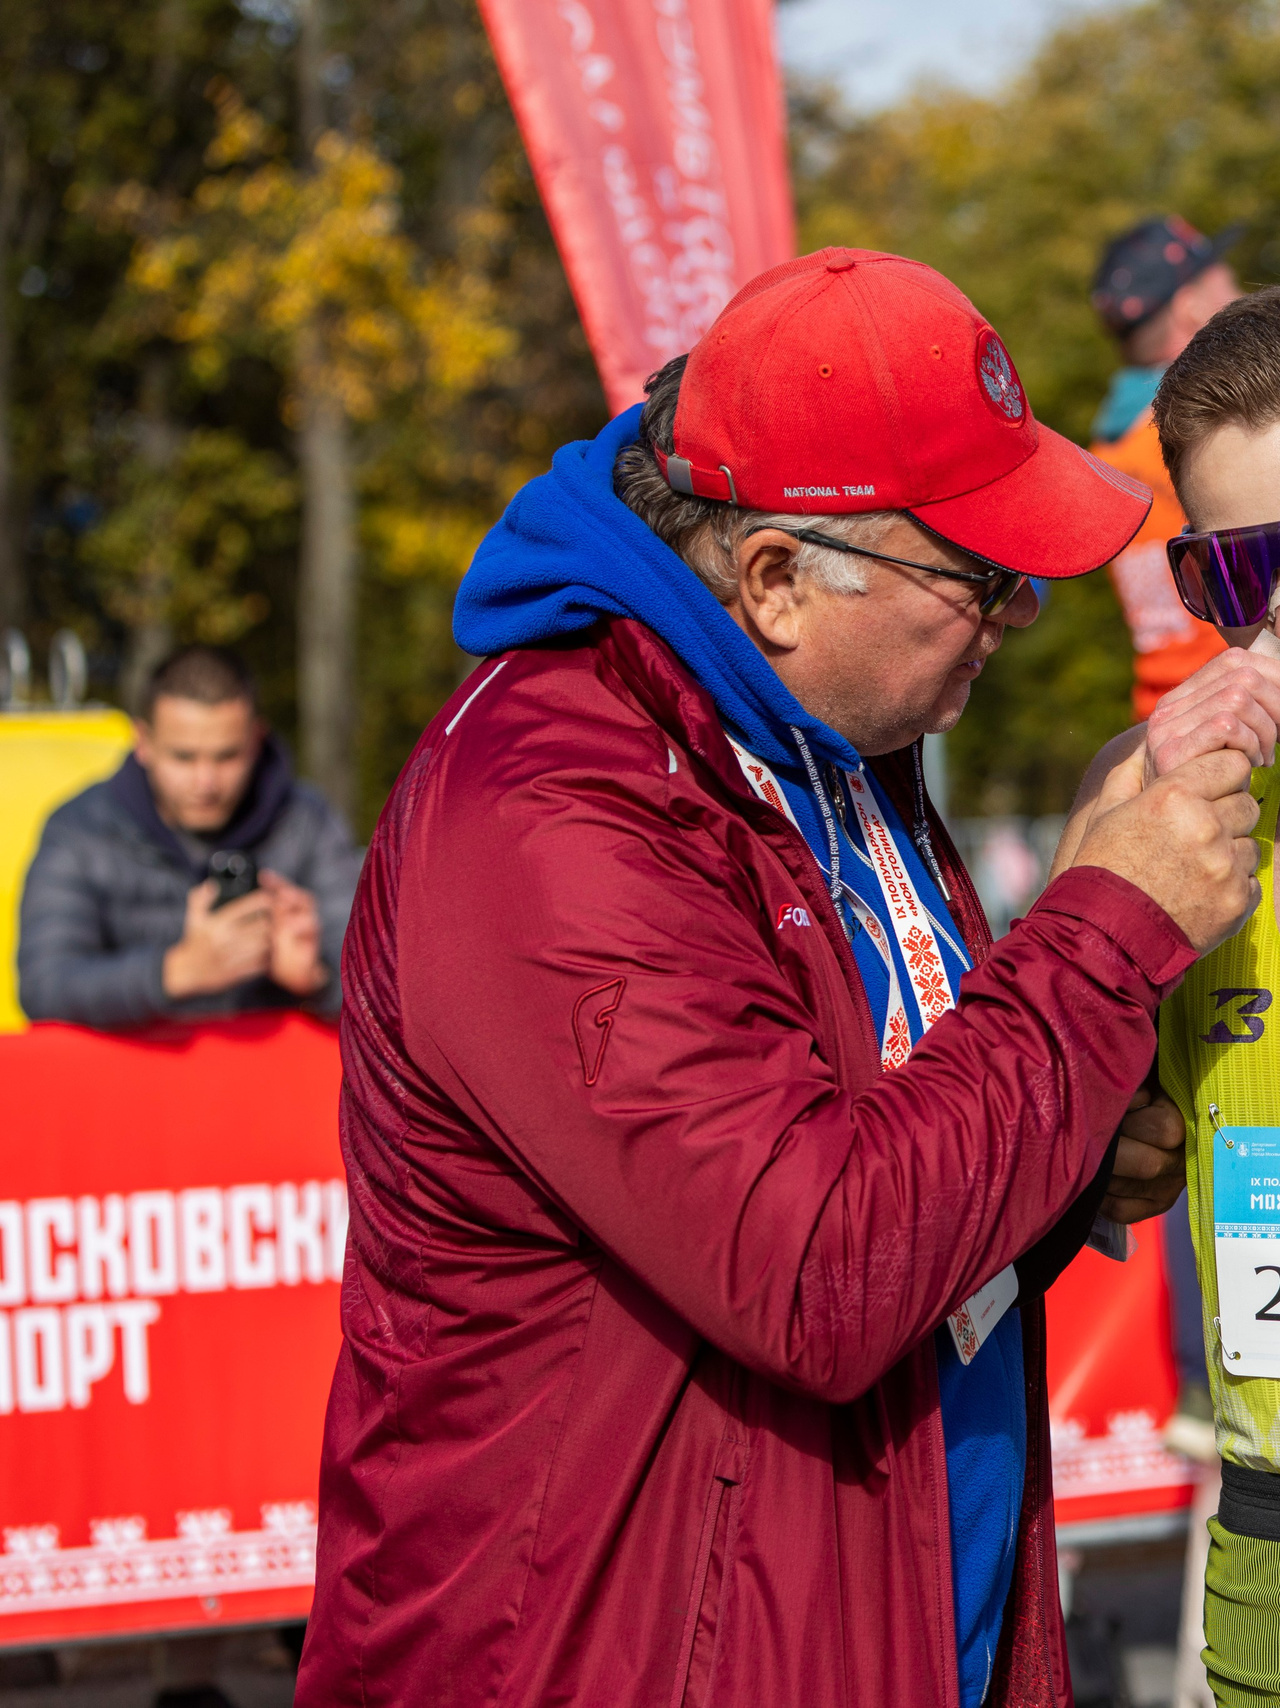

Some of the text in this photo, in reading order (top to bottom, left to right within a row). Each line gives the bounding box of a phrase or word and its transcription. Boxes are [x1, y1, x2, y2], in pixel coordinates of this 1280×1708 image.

[784, 485, 875, 498] NATIONAL TEAM
[856, 802, 907, 919] IX ПОЛУМАРАФОН
[871, 814, 918, 916] «МОЯ СТОЛИЦА»
[1251, 1178, 1261, 1186] IX
